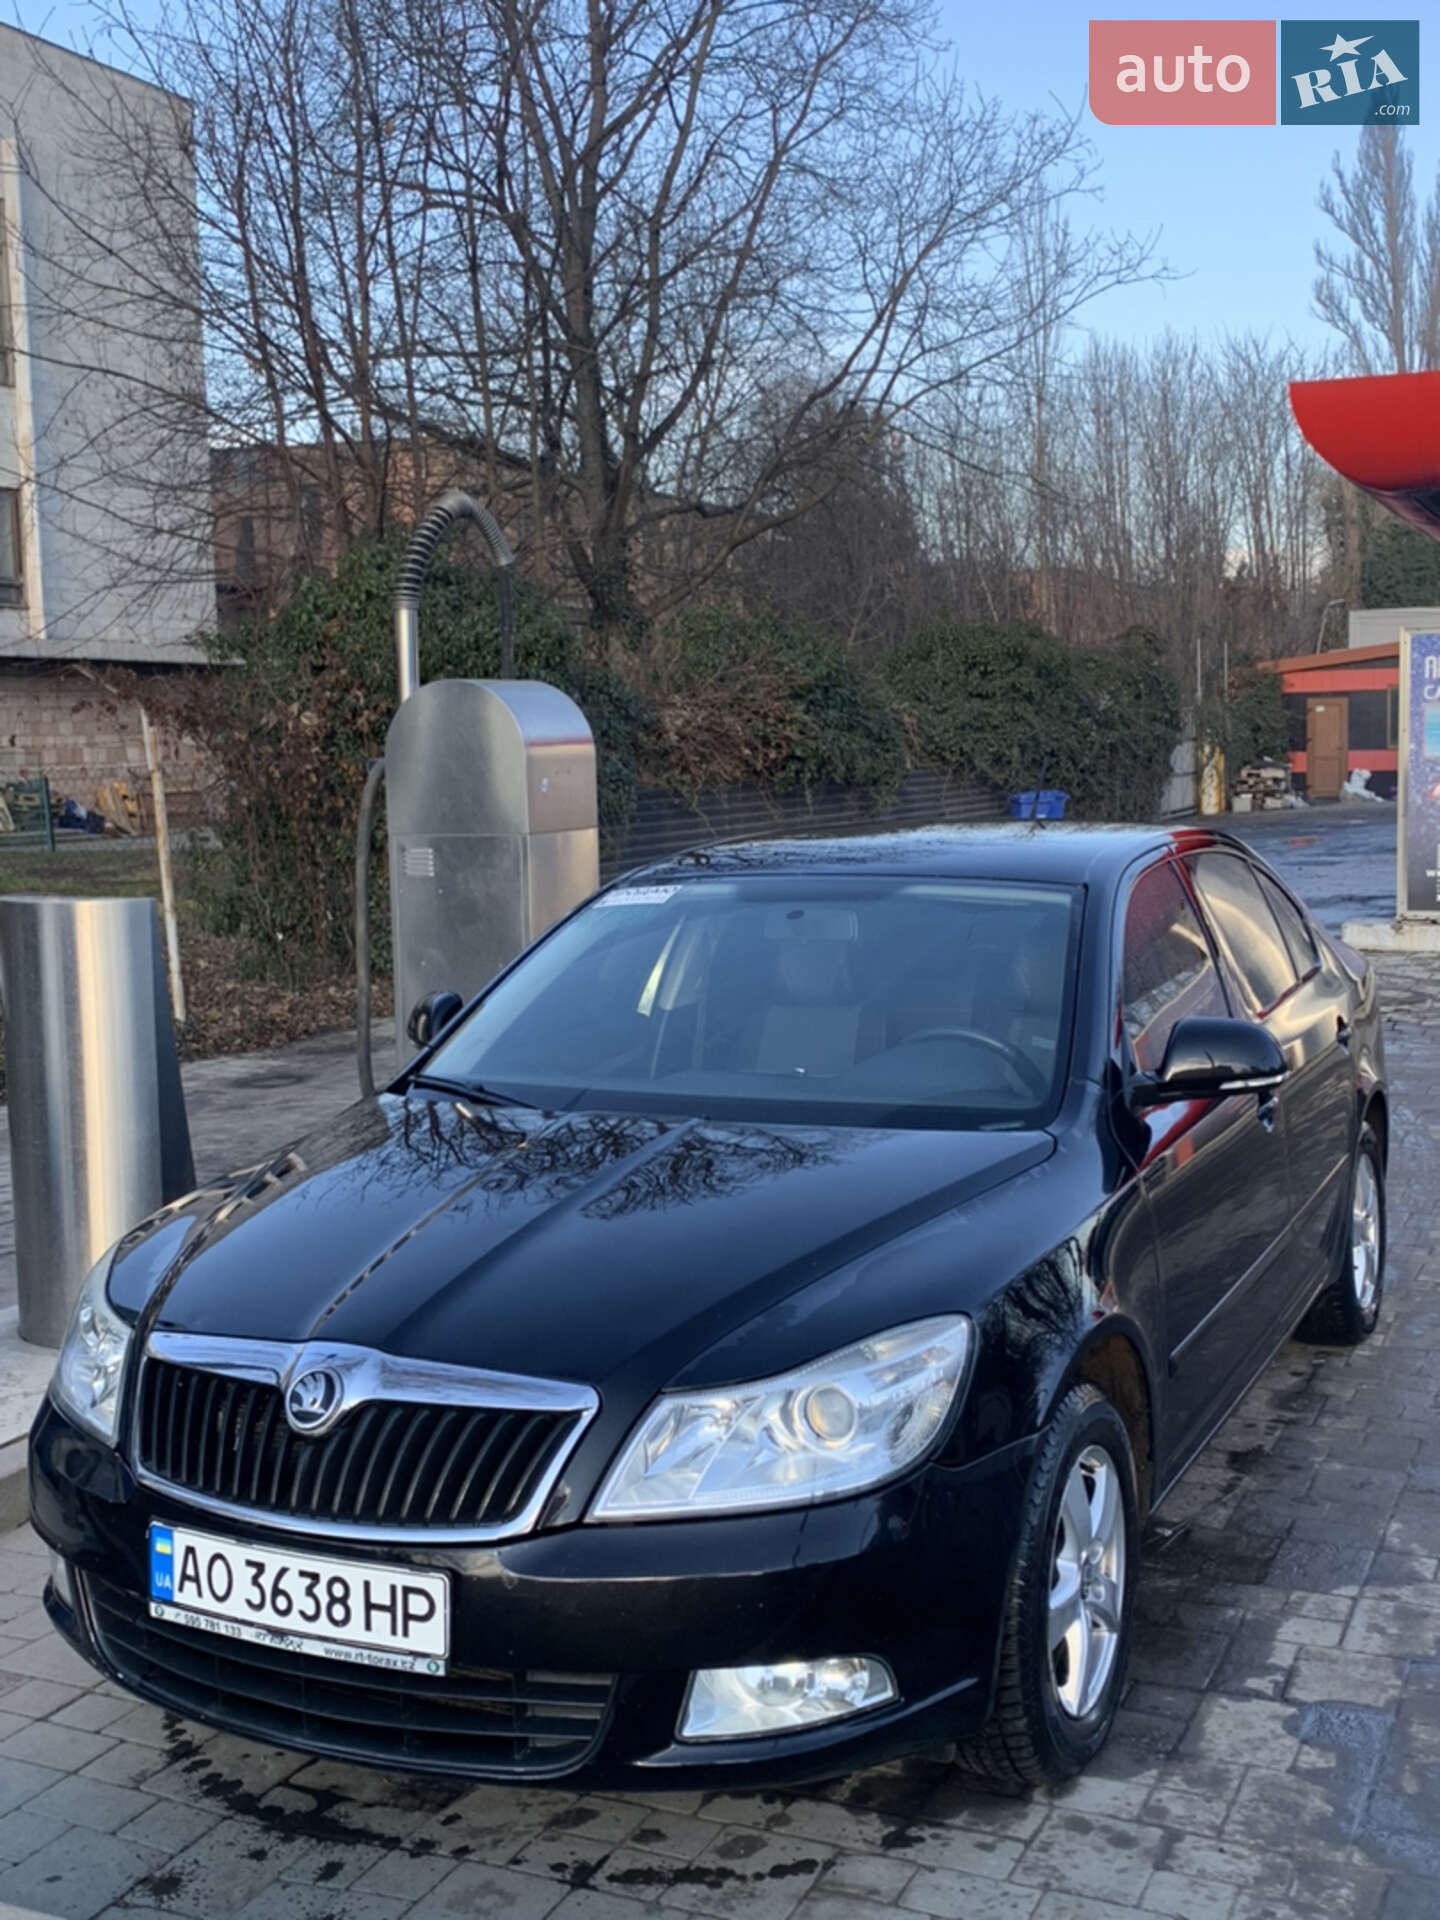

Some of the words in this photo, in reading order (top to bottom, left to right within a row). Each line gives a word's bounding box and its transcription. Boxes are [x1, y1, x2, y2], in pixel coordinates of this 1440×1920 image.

[155, 1571, 172, 1590] UA
[178, 1545, 233, 1603] AO
[245, 1559, 351, 1628] 3638
[364, 1580, 436, 1639] HP
